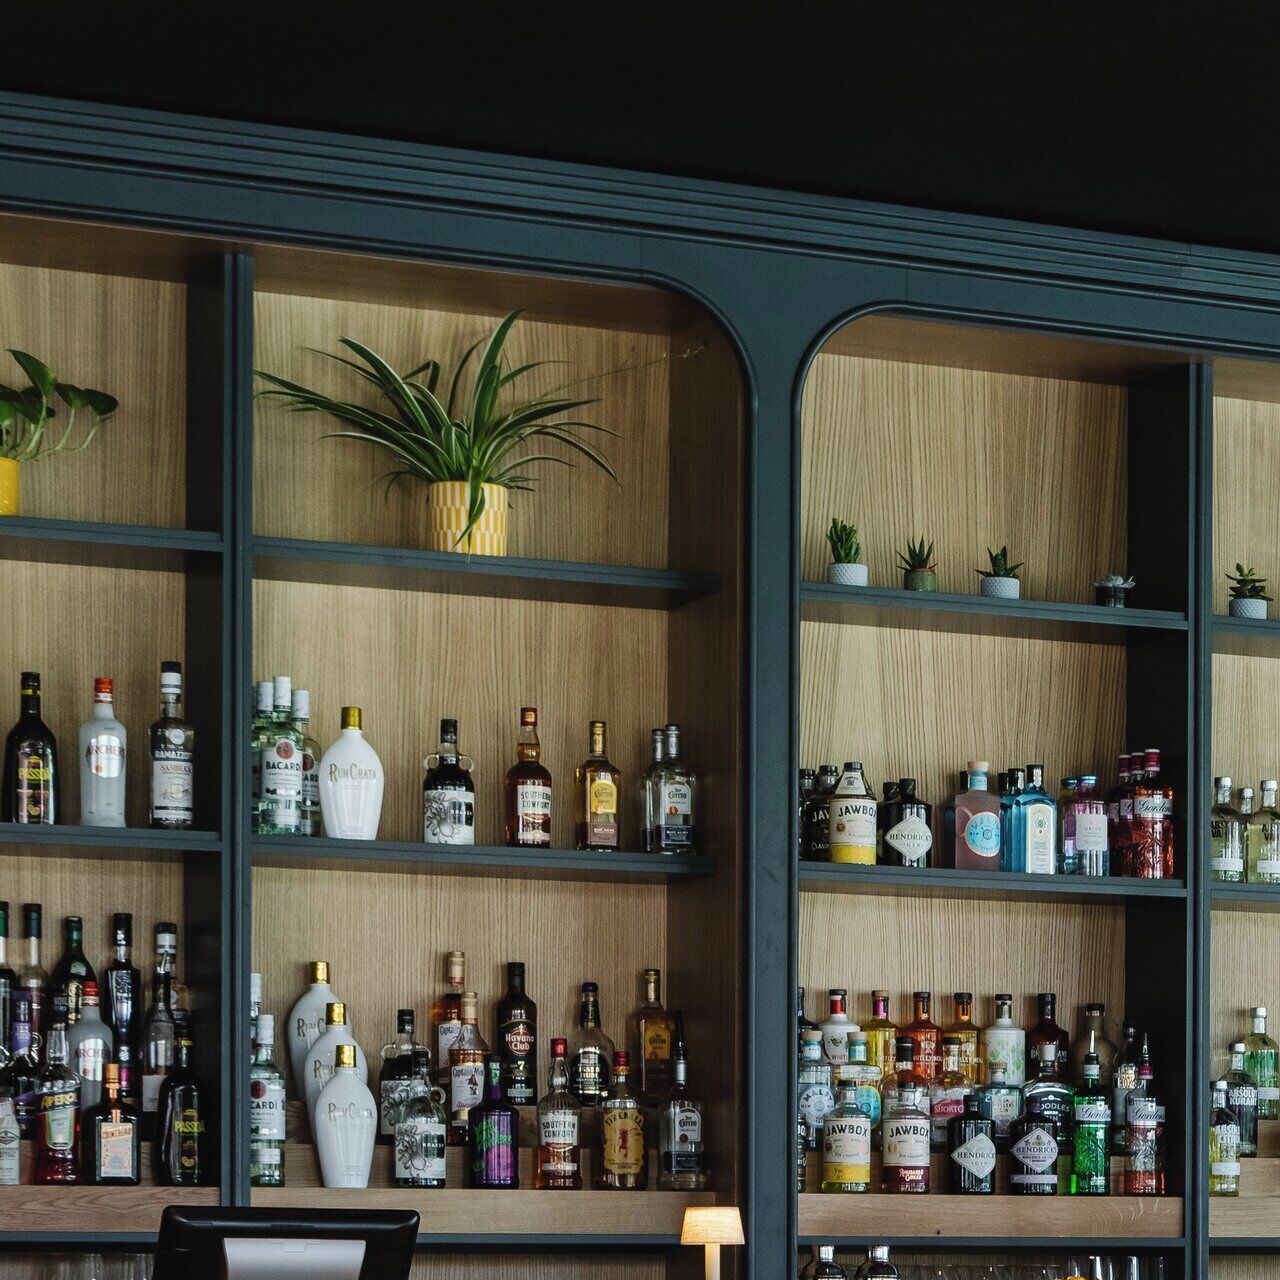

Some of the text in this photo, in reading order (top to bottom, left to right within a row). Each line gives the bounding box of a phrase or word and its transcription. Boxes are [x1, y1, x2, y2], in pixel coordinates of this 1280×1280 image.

[505, 1032, 535, 1043] Havana
[511, 1042, 530, 1051] Club
[517, 1060, 525, 1072] 7
[40, 1092, 78, 1109] APEROL
[250, 1100, 278, 1110] CARDI
[1039, 1102, 1071, 1112] OODLES
[826, 1123, 868, 1137] JAWBOX
[889, 1125, 929, 1138] JAWBOX
